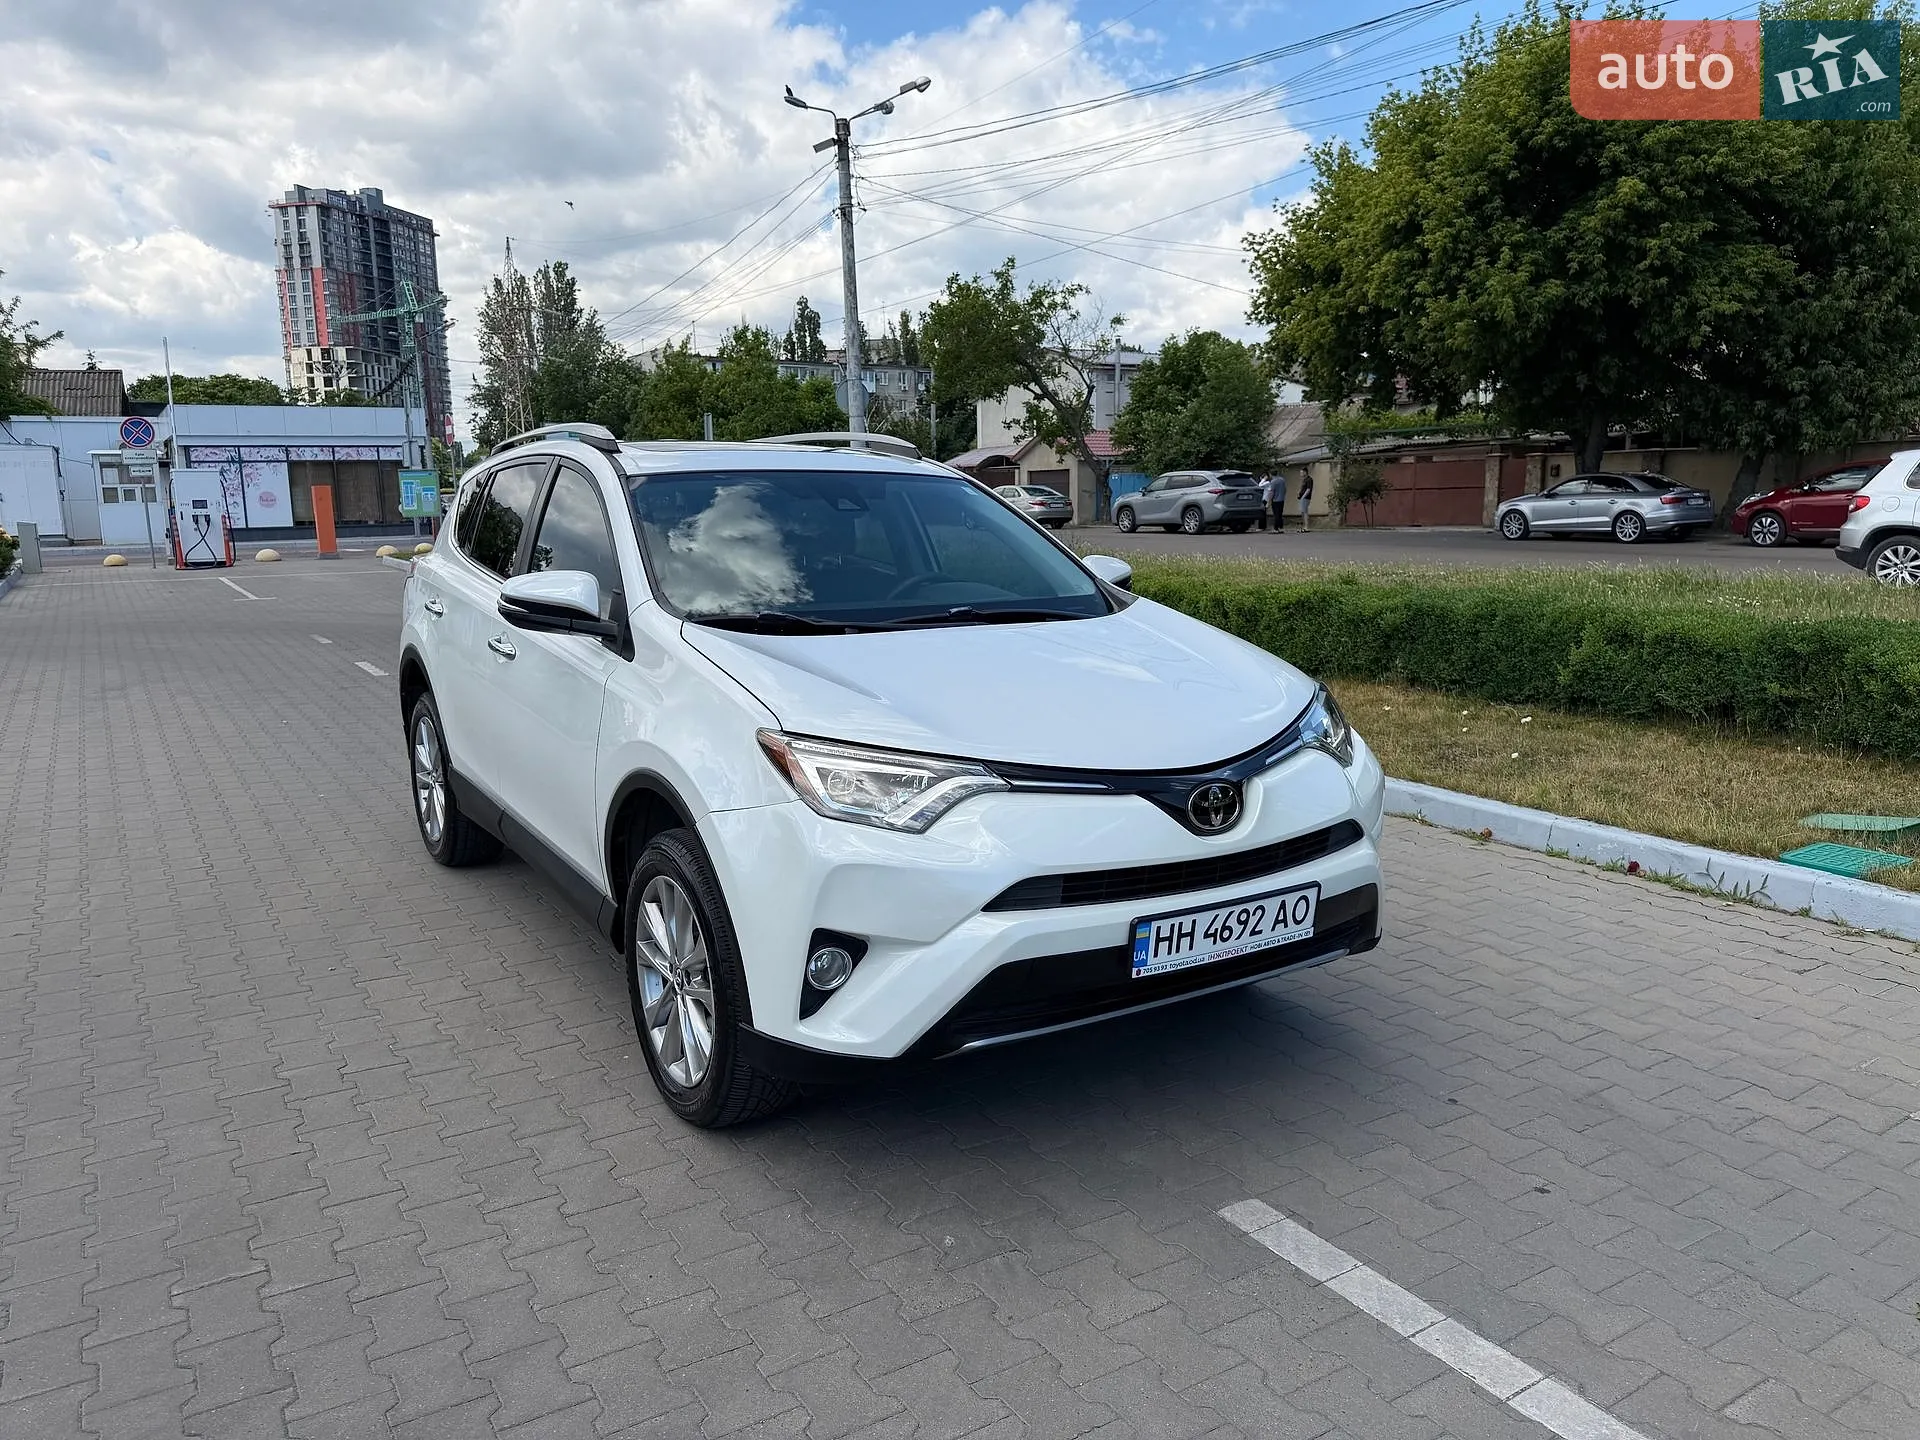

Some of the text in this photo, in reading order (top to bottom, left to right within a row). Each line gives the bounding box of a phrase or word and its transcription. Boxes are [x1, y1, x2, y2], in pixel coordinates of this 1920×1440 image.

[1153, 894, 1311, 958] HH 4692 AO
[1133, 950, 1147, 961] UA
